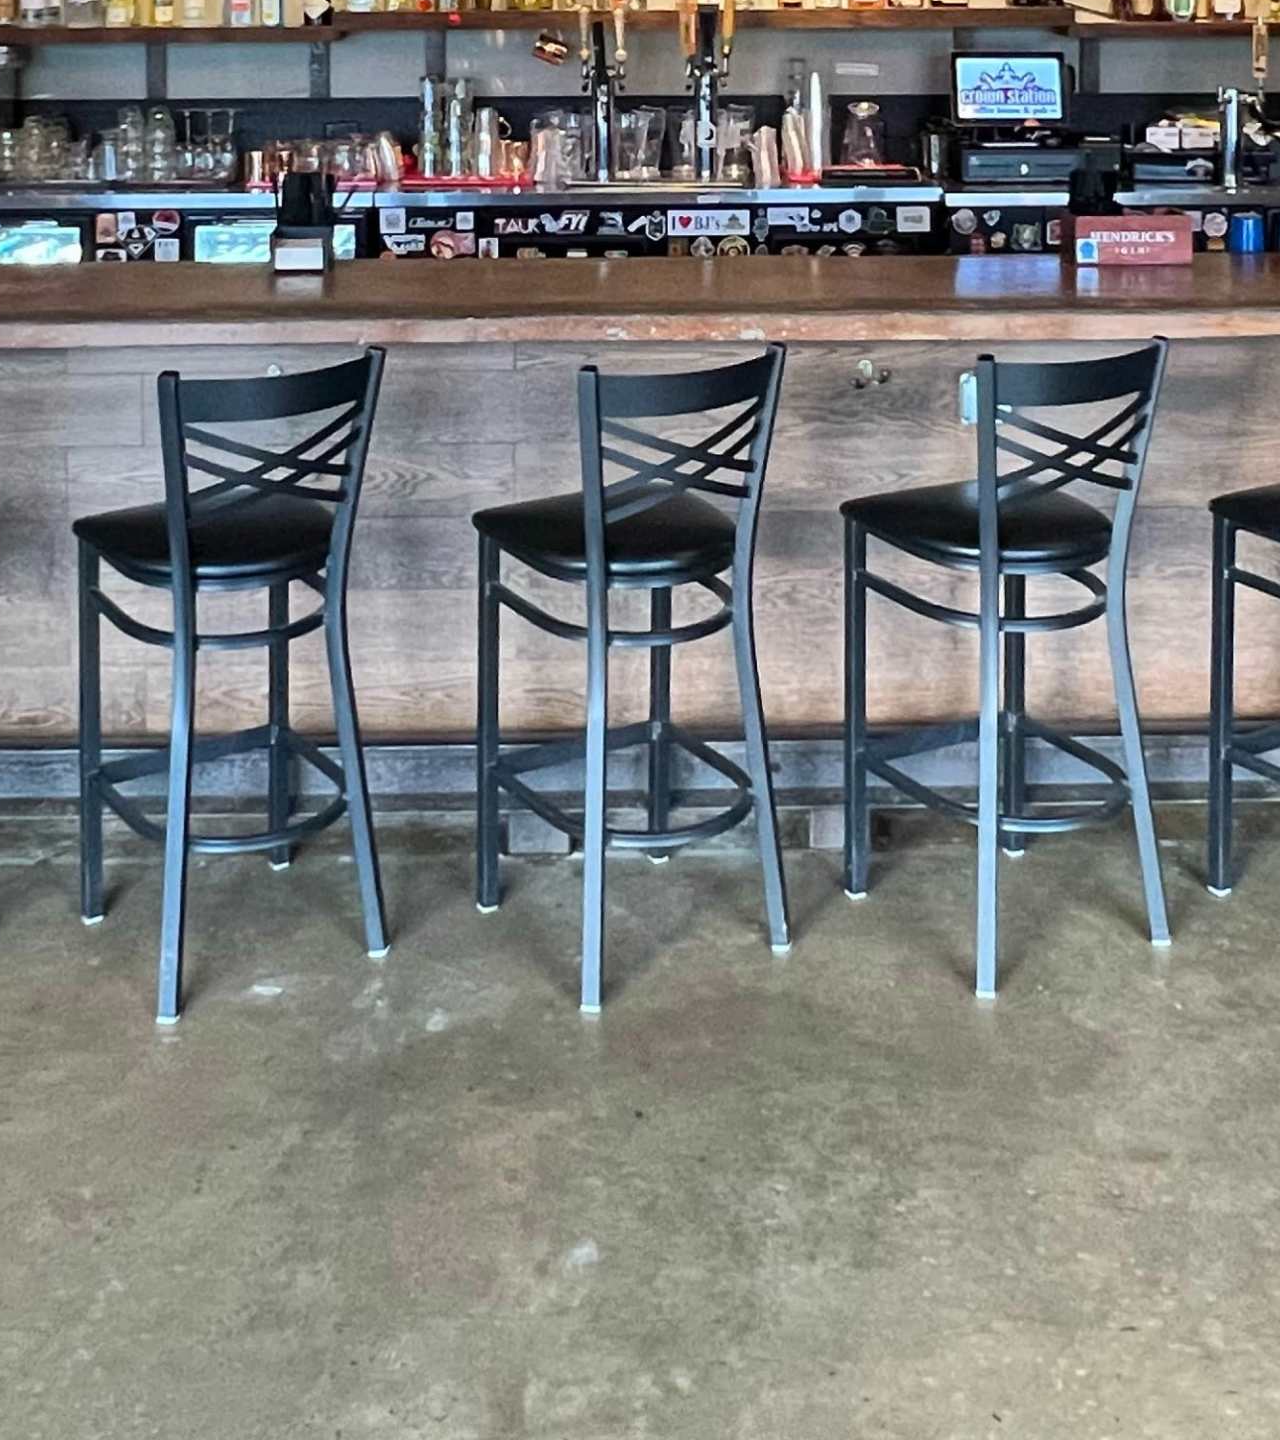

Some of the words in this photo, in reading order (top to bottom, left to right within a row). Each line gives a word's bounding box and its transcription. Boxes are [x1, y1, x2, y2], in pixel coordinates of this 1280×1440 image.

[961, 89, 1005, 105] crown
[1007, 88, 1056, 105] station
[671, 216, 677, 231] I
[693, 215, 721, 232] BJ's
[1090, 230, 1175, 243] HENDRICK'S
